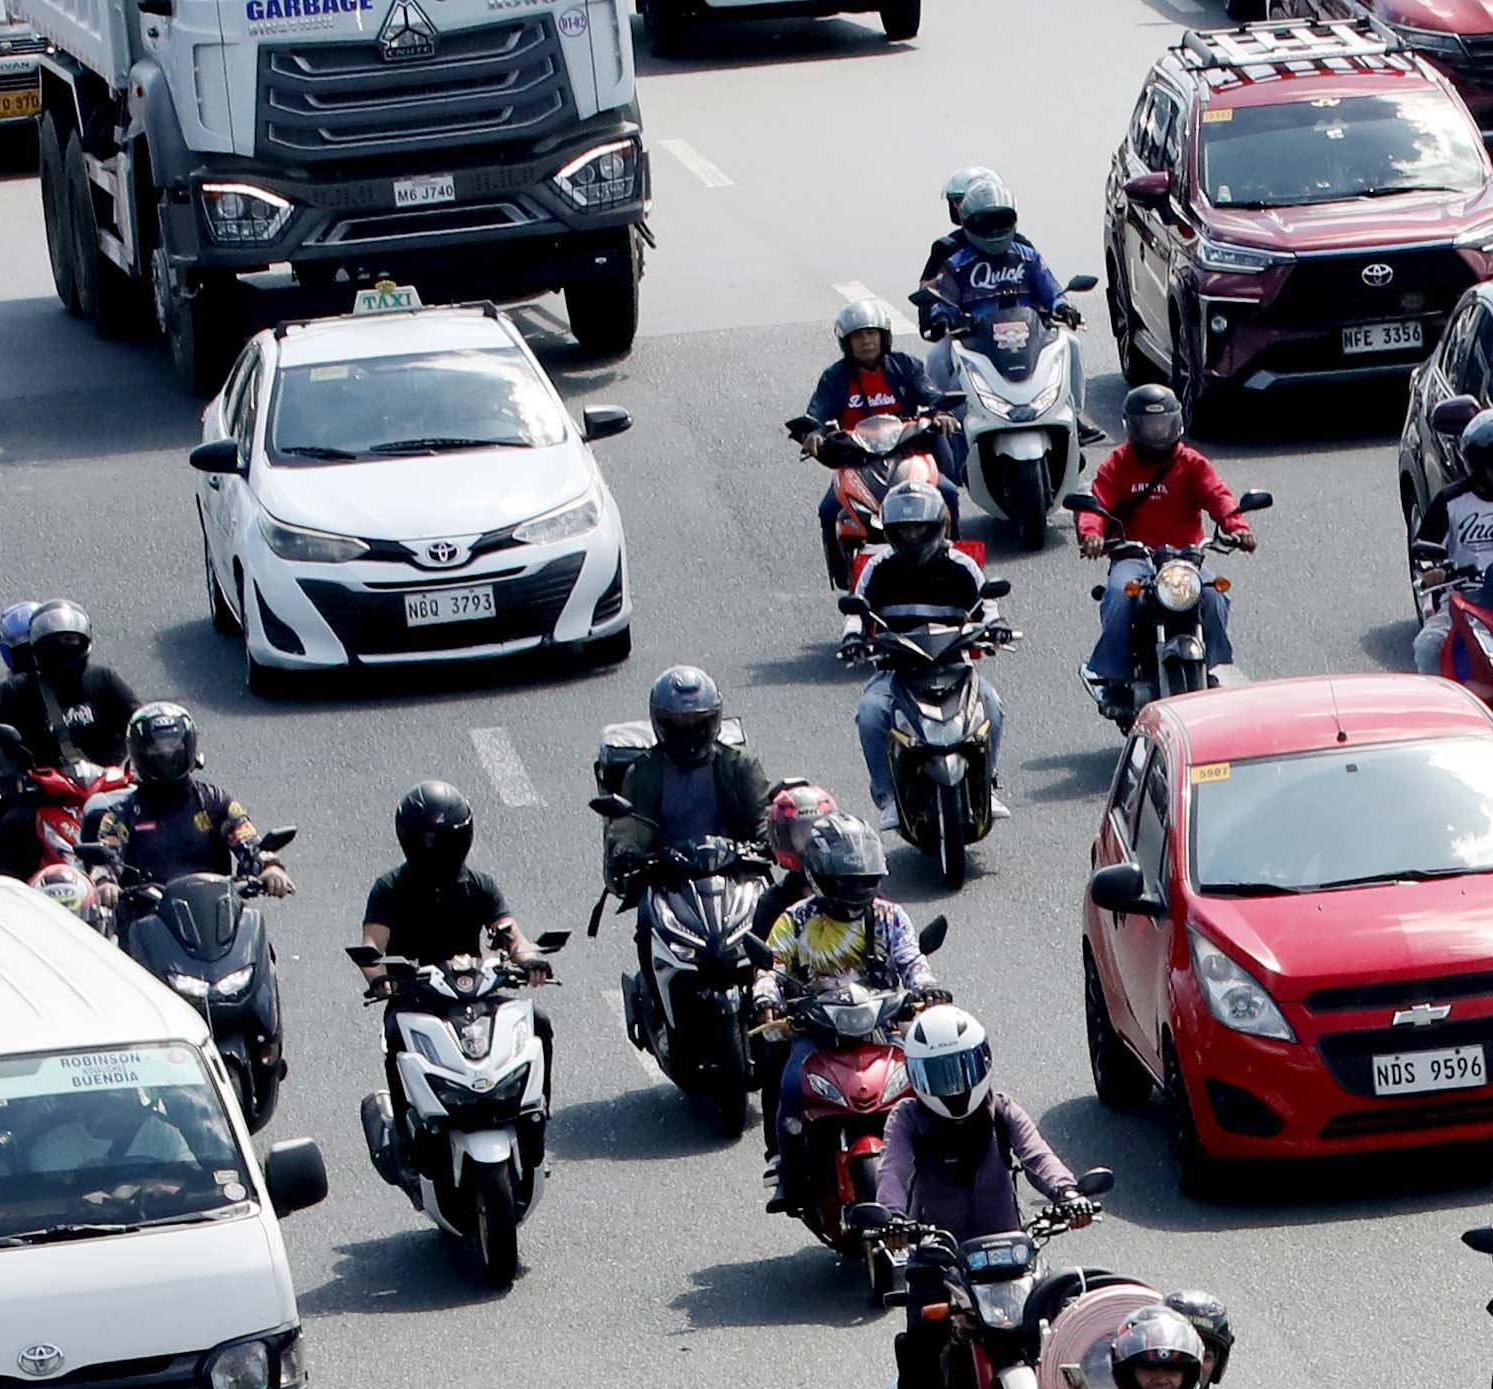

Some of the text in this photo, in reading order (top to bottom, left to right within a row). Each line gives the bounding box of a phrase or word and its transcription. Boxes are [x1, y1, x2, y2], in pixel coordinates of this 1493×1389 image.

[397, 184, 454, 202] M6 J740
[969, 262, 1026, 291] Quick
[364, 292, 413, 311] TAXI
[1343, 323, 1421, 347] NFE 3356
[407, 593, 492, 622] NBQ 3793
[60, 1052, 141, 1069] ROBINSON
[1375, 1055, 1483, 1087] NDS 9596
[72, 1071, 139, 1088] BUENDIA
